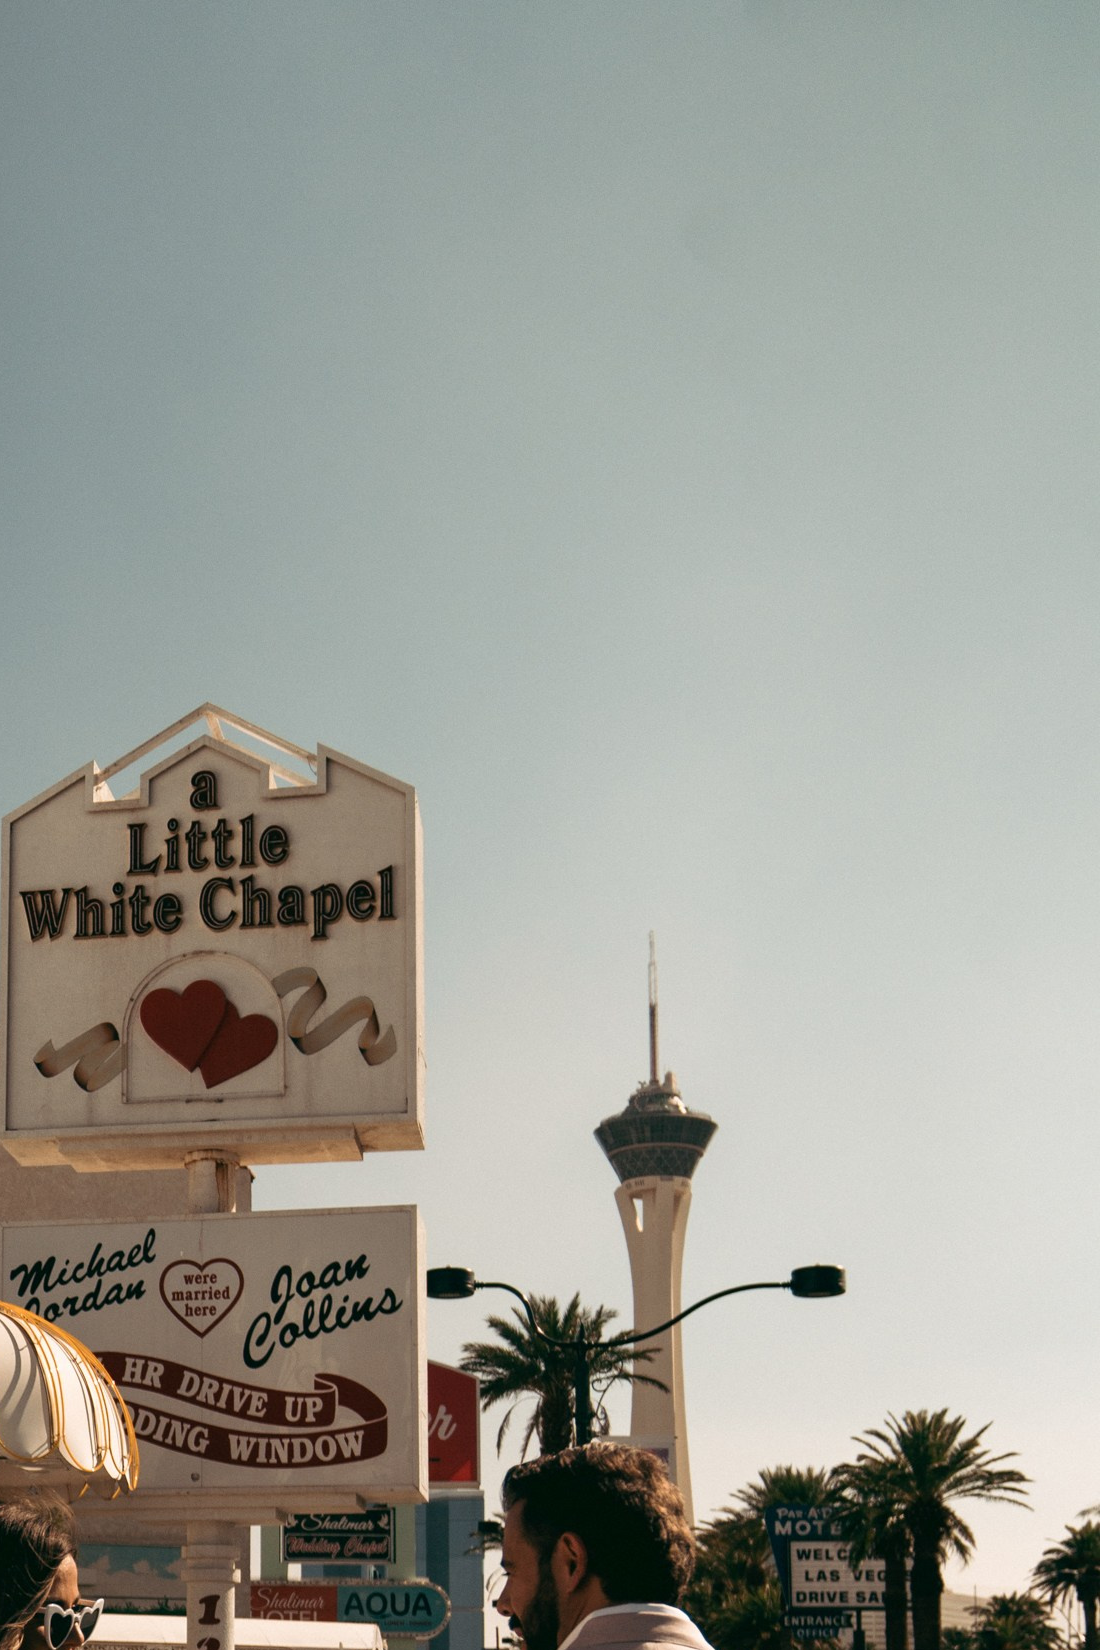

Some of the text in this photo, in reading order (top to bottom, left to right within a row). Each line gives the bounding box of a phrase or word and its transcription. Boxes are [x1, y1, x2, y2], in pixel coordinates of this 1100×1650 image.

[189, 770, 218, 810] a
[126, 813, 289, 877] Little
[19, 864, 398, 942] White Chapel
[10, 1228, 156, 1297] Michael
[183, 1272, 218, 1285] were
[270, 1253, 370, 1325] Joan
[171, 1286, 231, 1301] married
[184, 1303, 217, 1317] here
[242, 1287, 403, 1369] Collins
[121, 1357, 324, 1424] HR DRIVE UP
[228, 1430, 365, 1464] WINDOW
[301, 1513, 375, 1532] Shalimar
[774, 1520, 842, 1536] MOTE
[805, 1570, 841, 1582] LAS
[251, 1587, 325, 1611] Shalimar
[344, 1591, 432, 1617] AQUA
[796, 1591, 849, 1603] DRIVE
